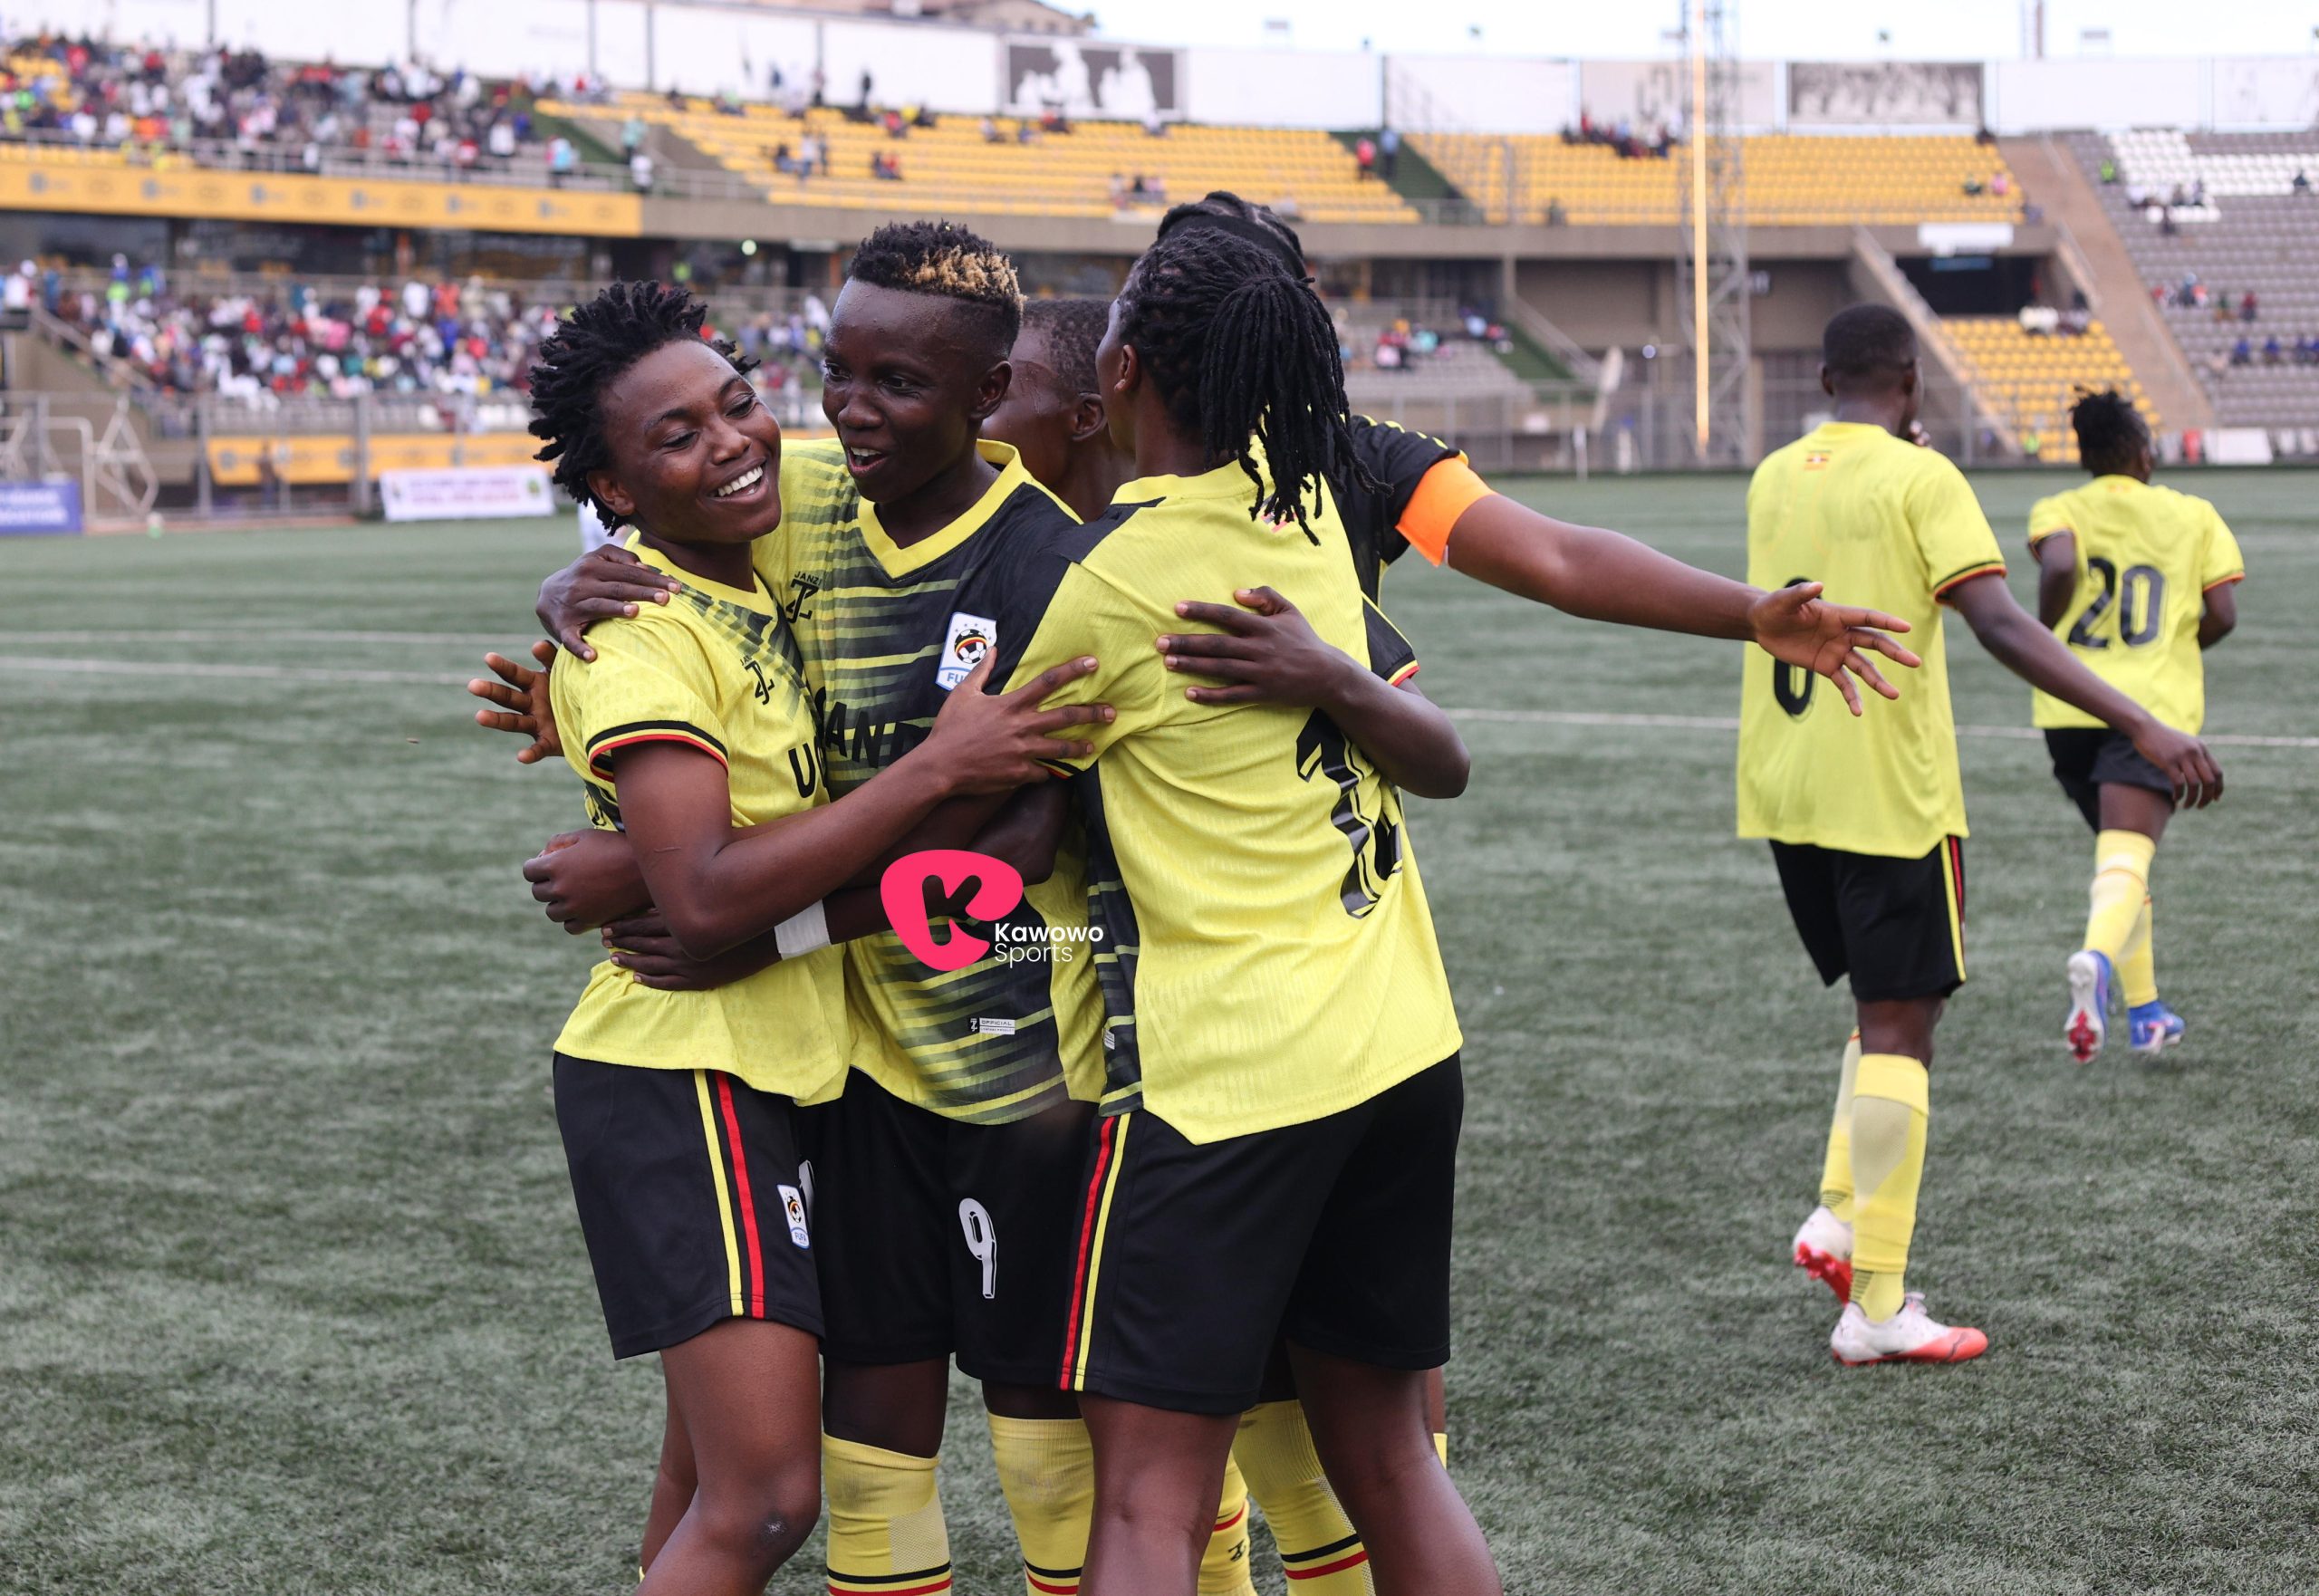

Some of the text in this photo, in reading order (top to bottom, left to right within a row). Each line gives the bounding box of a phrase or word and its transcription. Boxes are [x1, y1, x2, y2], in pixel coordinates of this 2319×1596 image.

[794, 571, 822, 585] JANZI
[2068, 555, 2168, 649] 20
[947, 672, 966, 684] FU
[959, 1197, 996, 1299] 9
